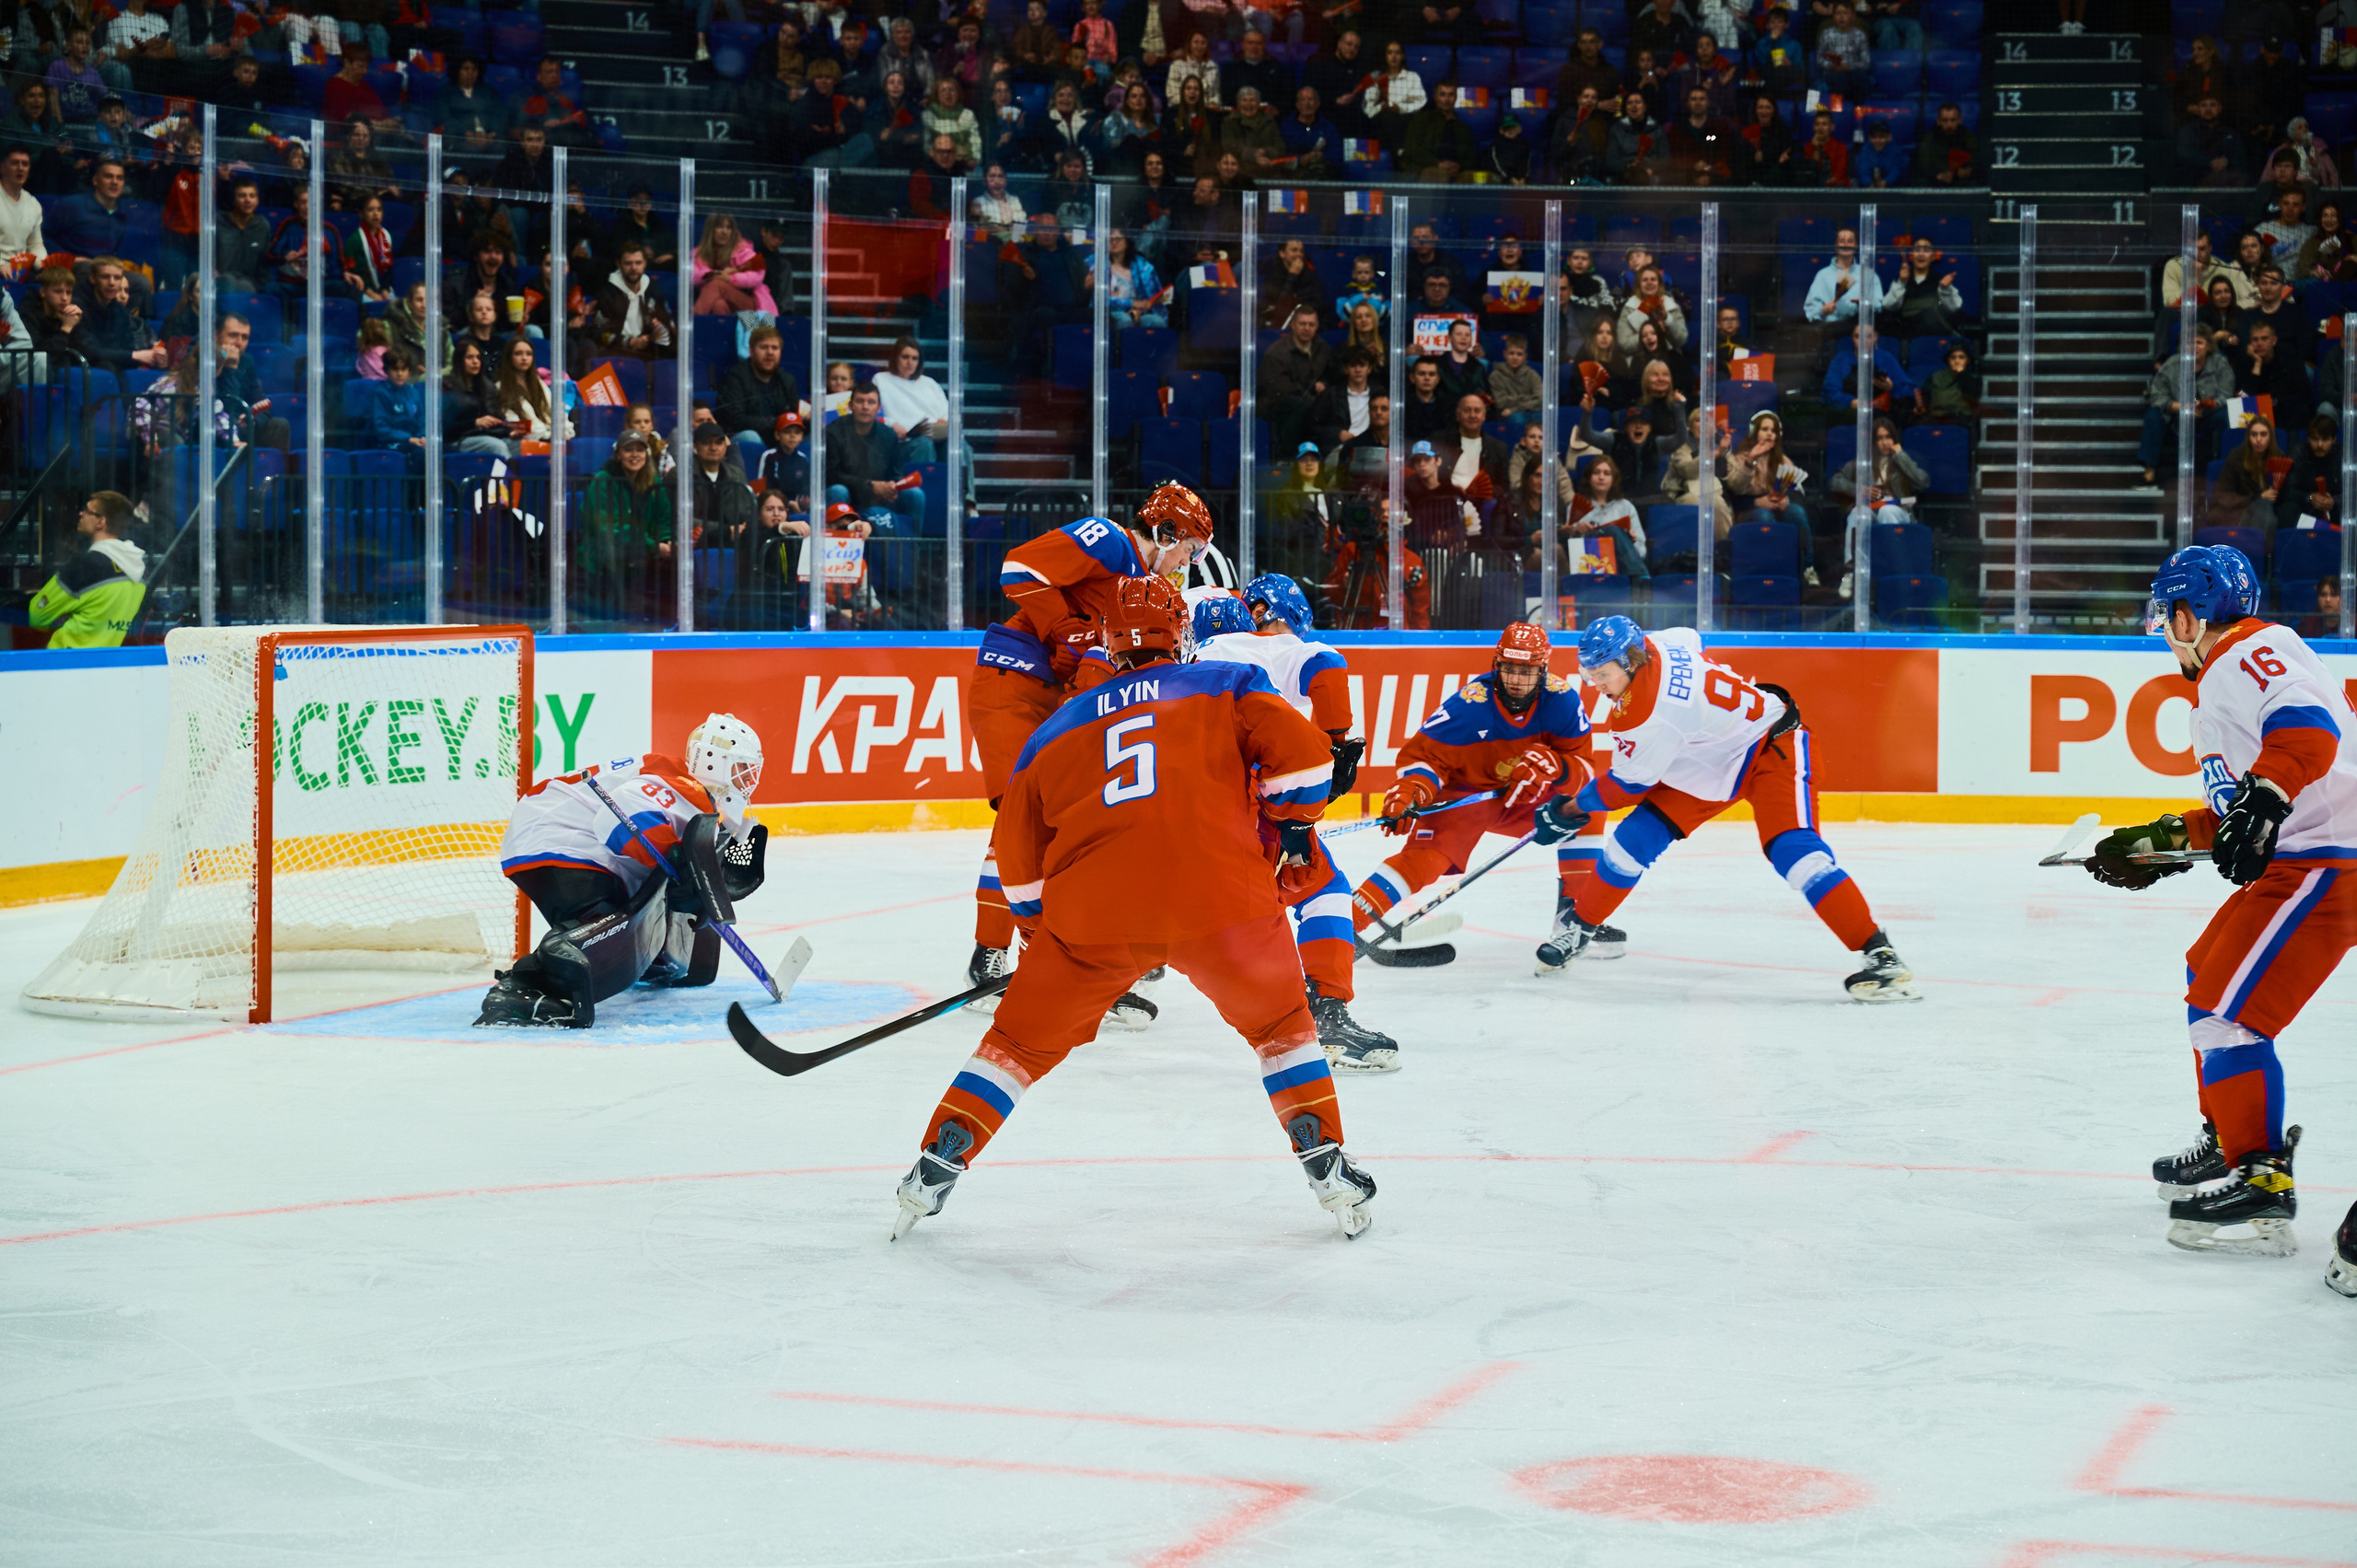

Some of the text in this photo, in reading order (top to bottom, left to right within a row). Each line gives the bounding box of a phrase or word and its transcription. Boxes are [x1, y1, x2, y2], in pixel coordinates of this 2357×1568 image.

[625, 11, 649, 32] 14
[2003, 41, 2026, 62] 14
[2110, 41, 2133, 61] 14
[662, 66, 688, 87] 13
[1997, 91, 2022, 111] 13
[2111, 91, 2137, 111] 13
[705, 120, 731, 141] 12
[1994, 145, 2019, 168] 12
[2111, 145, 2136, 168] 12
[749, 180, 768, 201] 11
[1995, 200, 2015, 220] 11
[2112, 201, 2134, 223] 11
[1074, 519, 1109, 547] 18
[2166, 583, 2187, 593] CCM
[1067, 630, 1096, 643] CC
[1131, 628, 1142, 646] 5
[1515, 630, 1530, 639] 27
[982, 651, 1036, 672] CCM
[1504, 649, 1530, 659] РОЛЬФ
[2239, 645, 2287, 693] 16
[1097, 679, 1160, 717] ILYIN
[791, 675, 982, 774] КРА
[1102, 713, 1157, 807] 5
[641, 783, 677, 809] 83
[580, 920, 630, 951] BAUER
